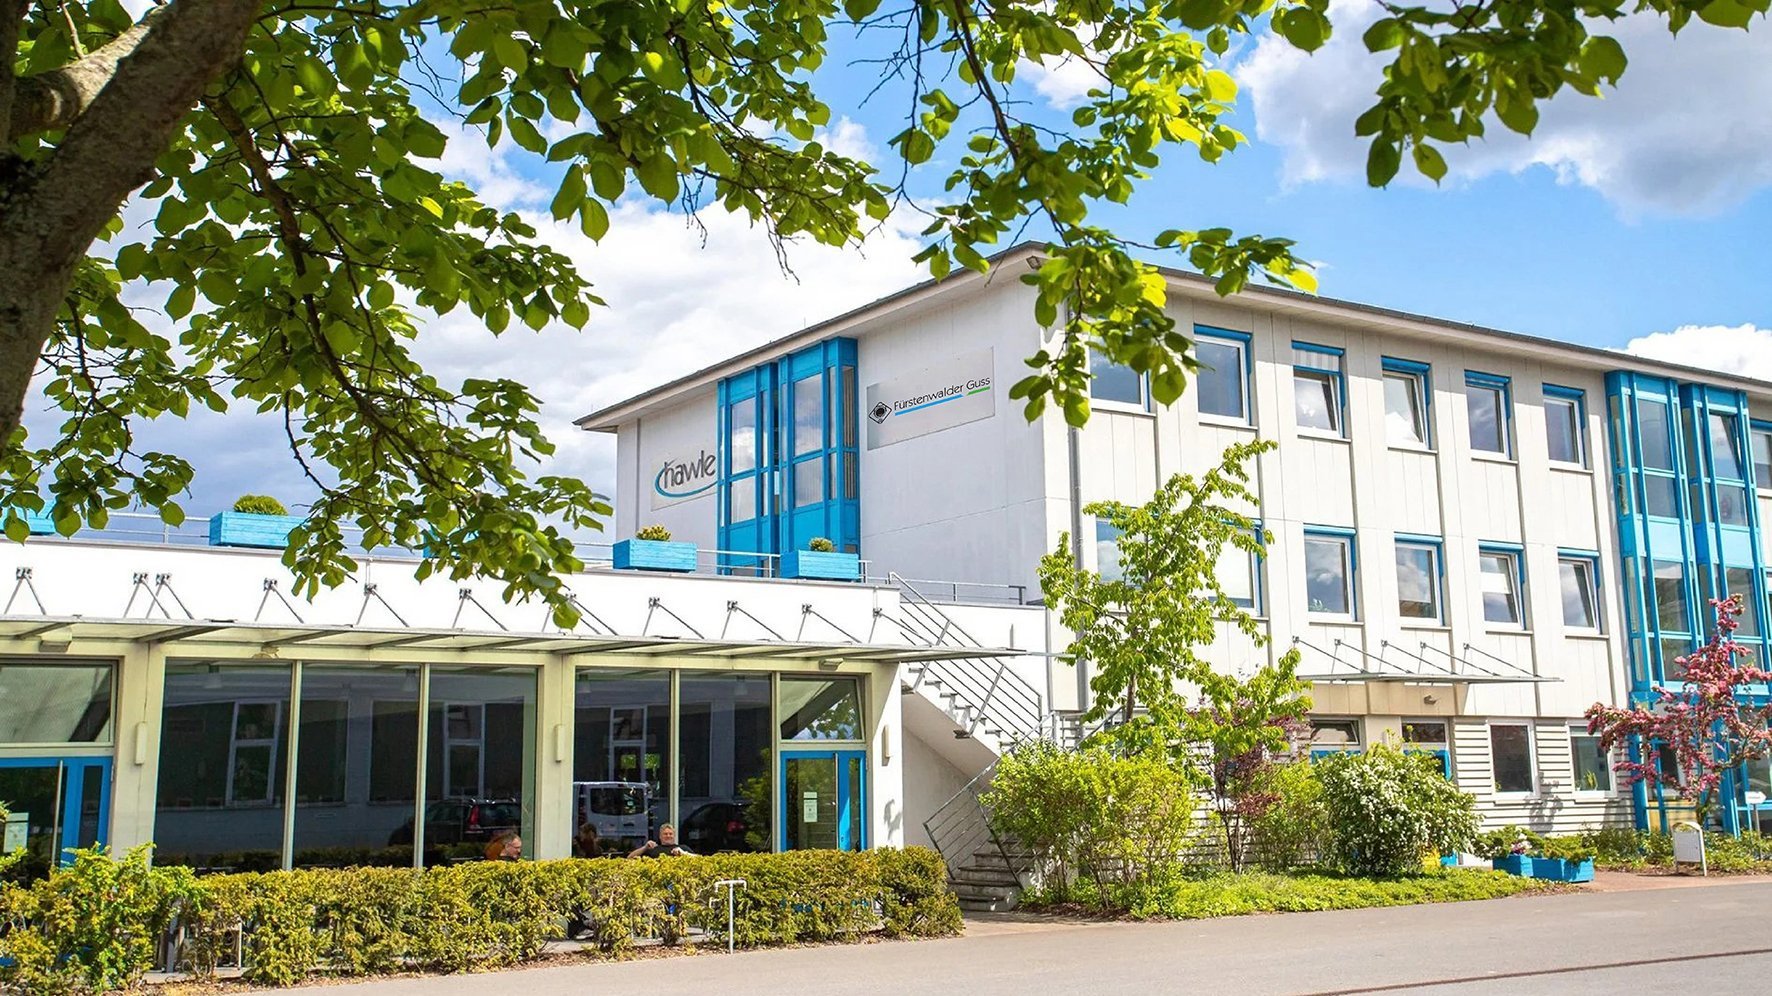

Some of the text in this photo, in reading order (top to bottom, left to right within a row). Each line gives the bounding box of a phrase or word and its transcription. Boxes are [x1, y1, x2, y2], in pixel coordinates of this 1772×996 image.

[893, 377, 991, 411] Fürstenwalder Guss
[664, 450, 716, 489] hawle
